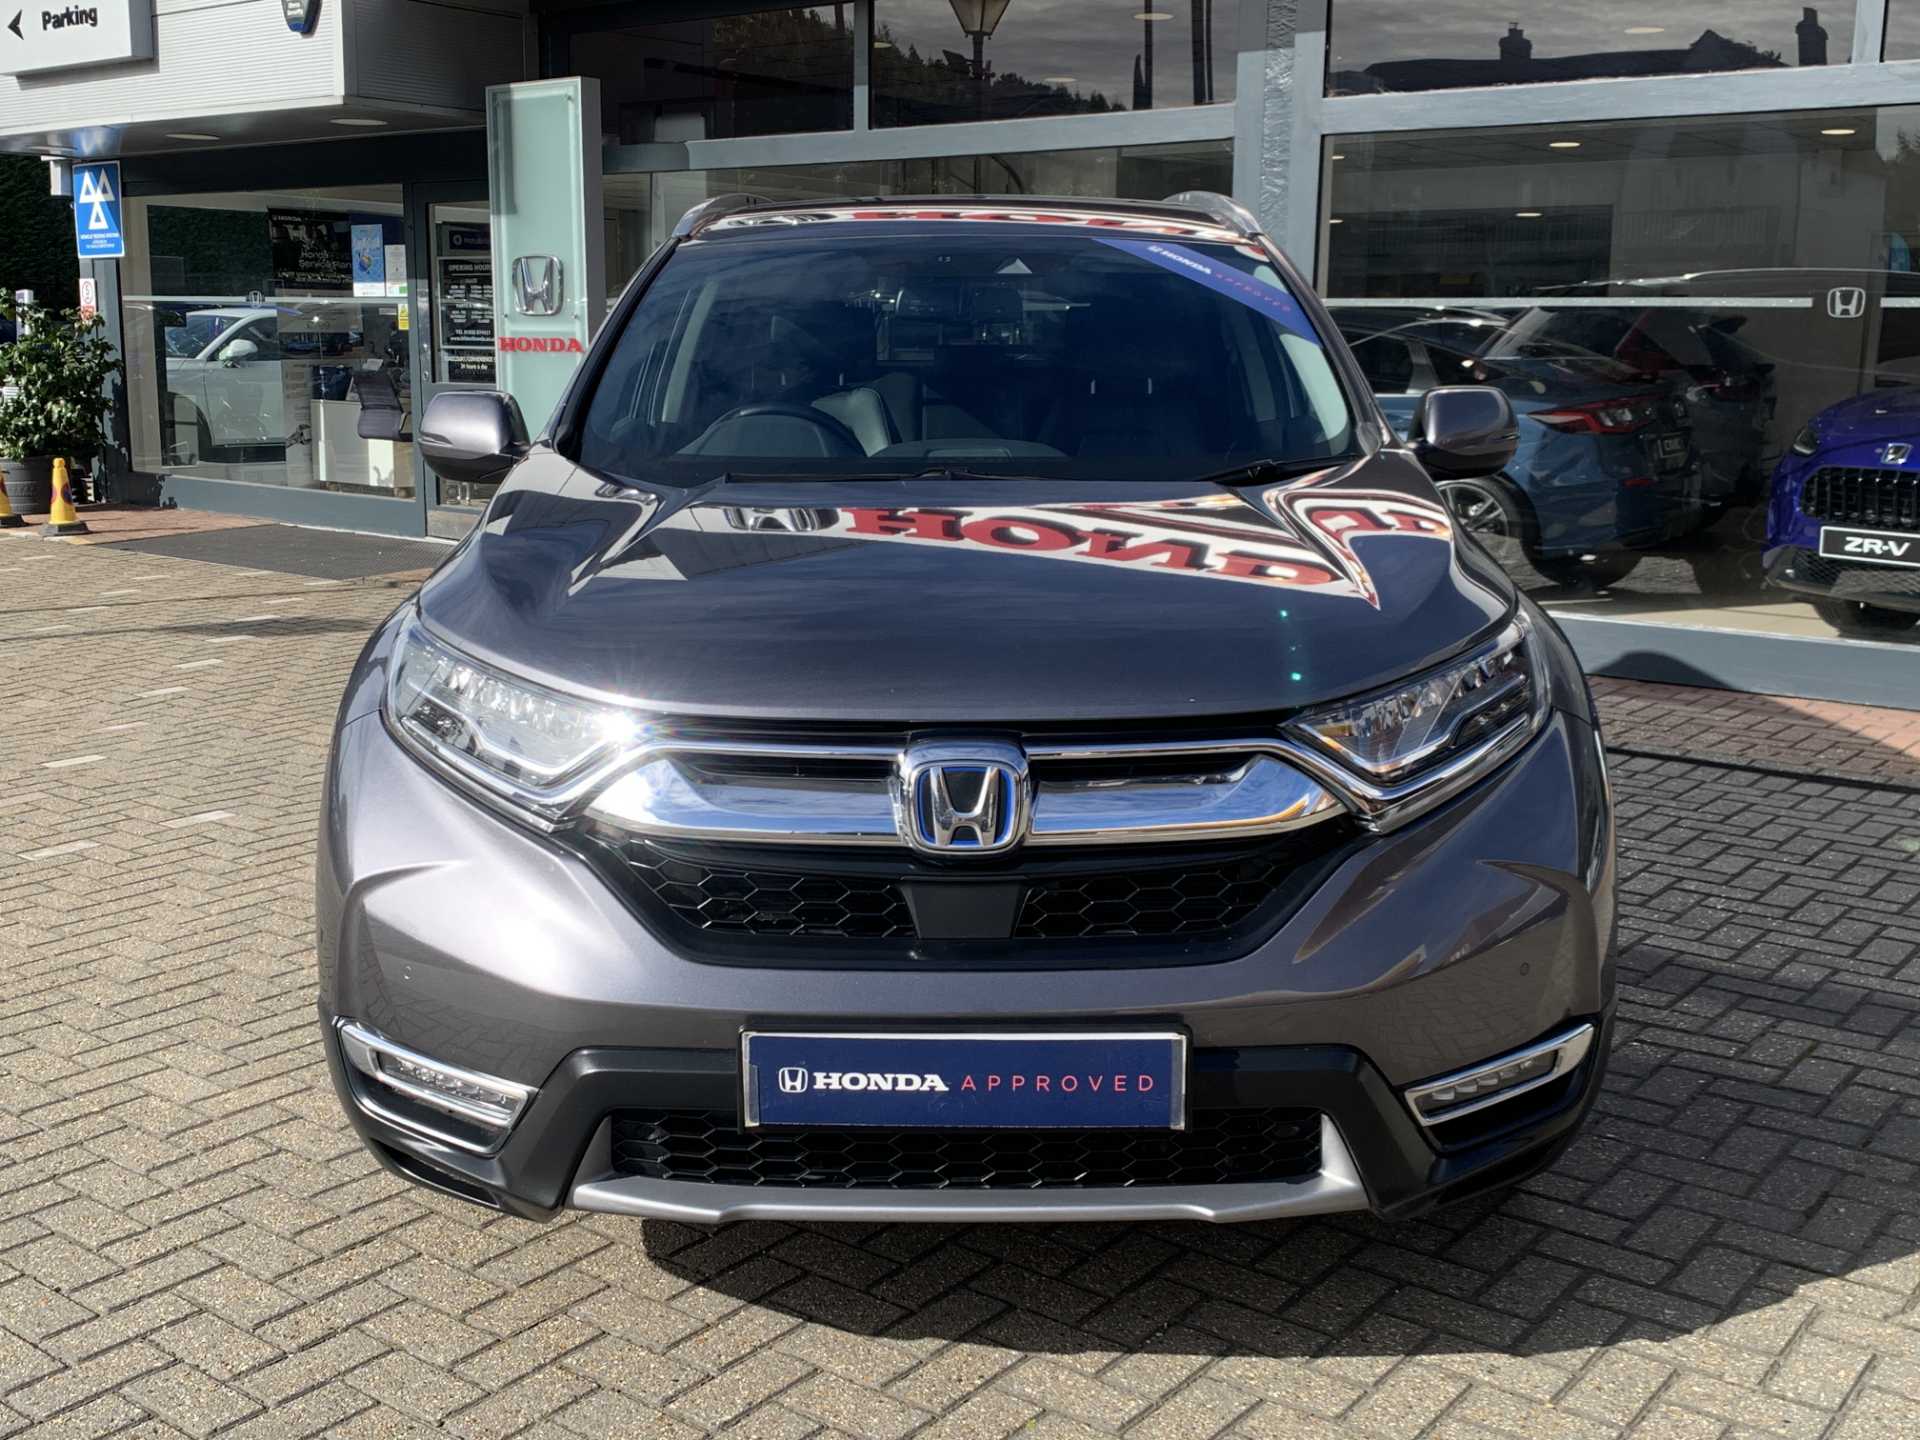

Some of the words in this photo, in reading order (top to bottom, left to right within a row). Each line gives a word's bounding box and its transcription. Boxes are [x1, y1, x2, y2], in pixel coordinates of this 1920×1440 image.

[41, 4, 98, 31] Parking
[1161, 249, 1213, 275] HONDA
[498, 336, 586, 353] HONDA
[813, 1071, 949, 1091] HONDA
[961, 1074, 1154, 1092] APPROVED
